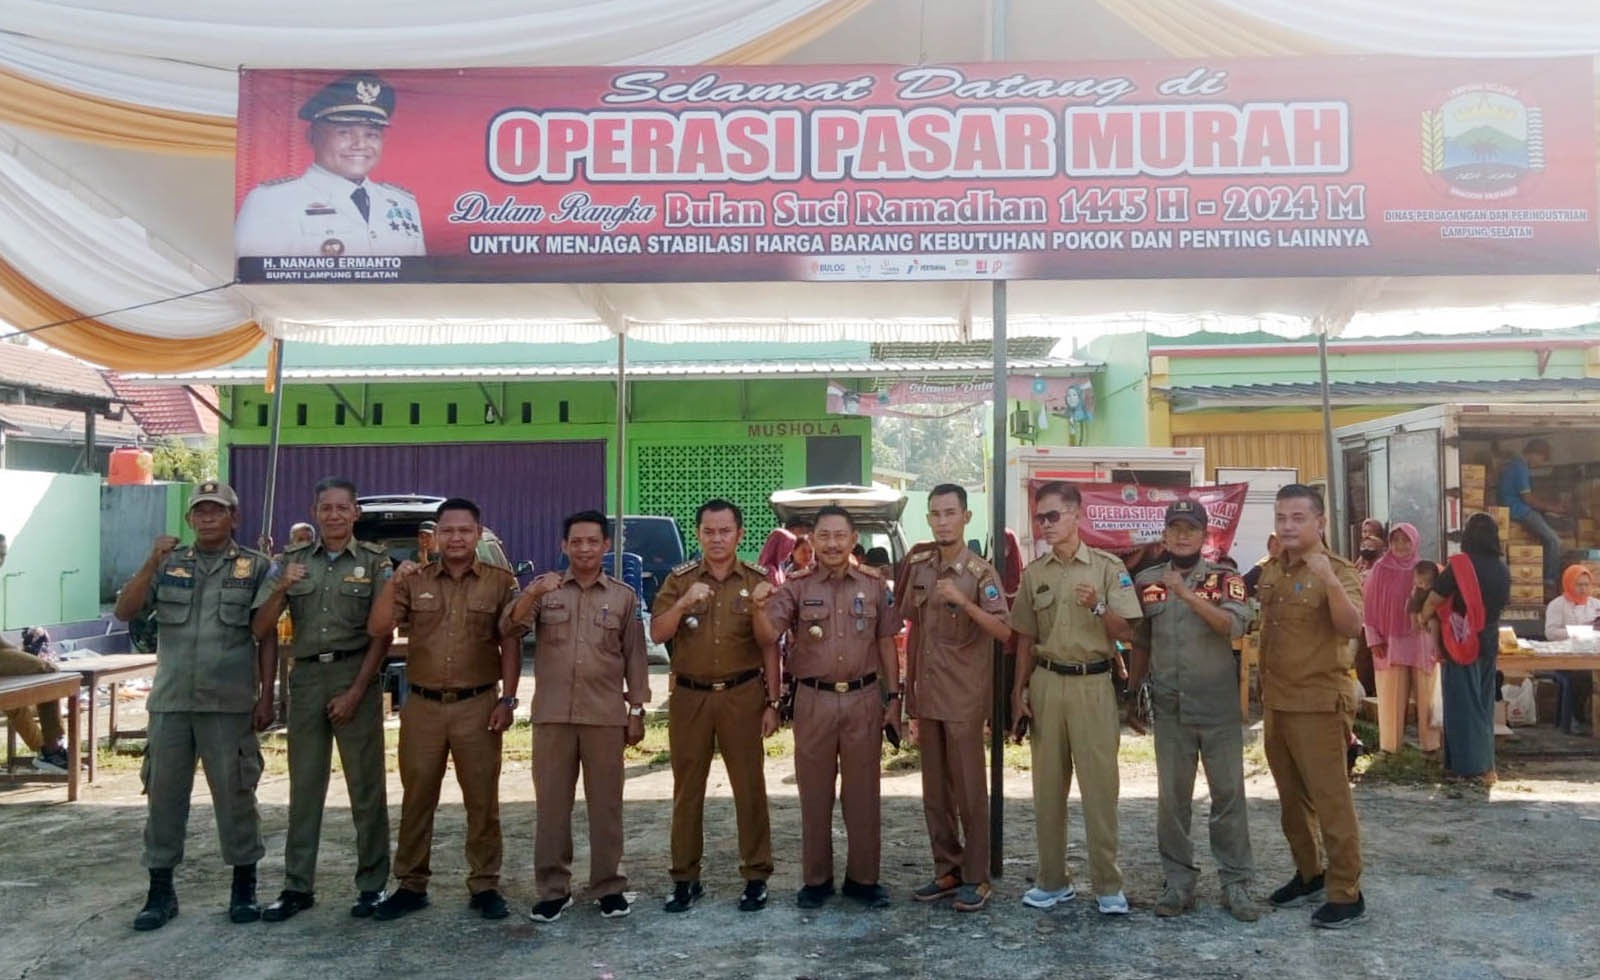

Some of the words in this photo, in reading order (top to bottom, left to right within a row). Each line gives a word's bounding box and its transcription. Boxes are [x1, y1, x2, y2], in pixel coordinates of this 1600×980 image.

[602, 70, 877, 104] Selamat
[896, 67, 1134, 106] Datang
[1160, 67, 1228, 96] di
[488, 109, 803, 183] OPERASI
[811, 107, 1056, 181] PASAR
[1065, 102, 1349, 176] MURAH
[449, 192, 545, 224] Dalam
[551, 192, 657, 231] Rangka
[665, 193, 765, 228] Bulan
[774, 190, 848, 226] Suci
[855, 189, 1048, 226] Ramadhan
[1059, 187, 1147, 223] 1445
[1156, 187, 1189, 222] H
[1223, 186, 1319, 222] 2024
[1326, 184, 1366, 220] M
[1385, 210, 1415, 222] DINAS
[1417, 210, 1487, 222] PERDAGANGAN
[1489, 210, 1509, 221] DAN
[1511, 210, 1587, 221] PERINDUSTRIAN
[1441, 227, 1489, 238] LAMPUNG
[1490, 226, 1533, 238] SELATAN
[469, 235, 540, 254] UNTUK
[546, 235, 642, 254] MENJAGA
[647, 235, 748, 253] STABILASI
[755, 235, 823, 253] HARGA
[830, 233, 913, 252] BARANG
[919, 232, 1046, 251] KEBUTUHAN
[1052, 231, 1124, 250] POKOK
[1131, 230, 1173, 248] DAN
[1179, 229, 1271, 248] PENTING
[1278, 228, 1369, 247] LAINNYA
[263, 258, 276, 268] H.
[280, 258, 335, 268] NANANG
[338, 257, 401, 268] ERMANTO
[820, 264, 846, 272] BULOG
[265, 271, 300, 279] BUPATI
[303, 271, 351, 279] LAMPUNG
[354, 271, 399, 279] SELATAN
[747, 421, 842, 438] MUSHOLA
[1086, 504, 1146, 521] OPERASI
